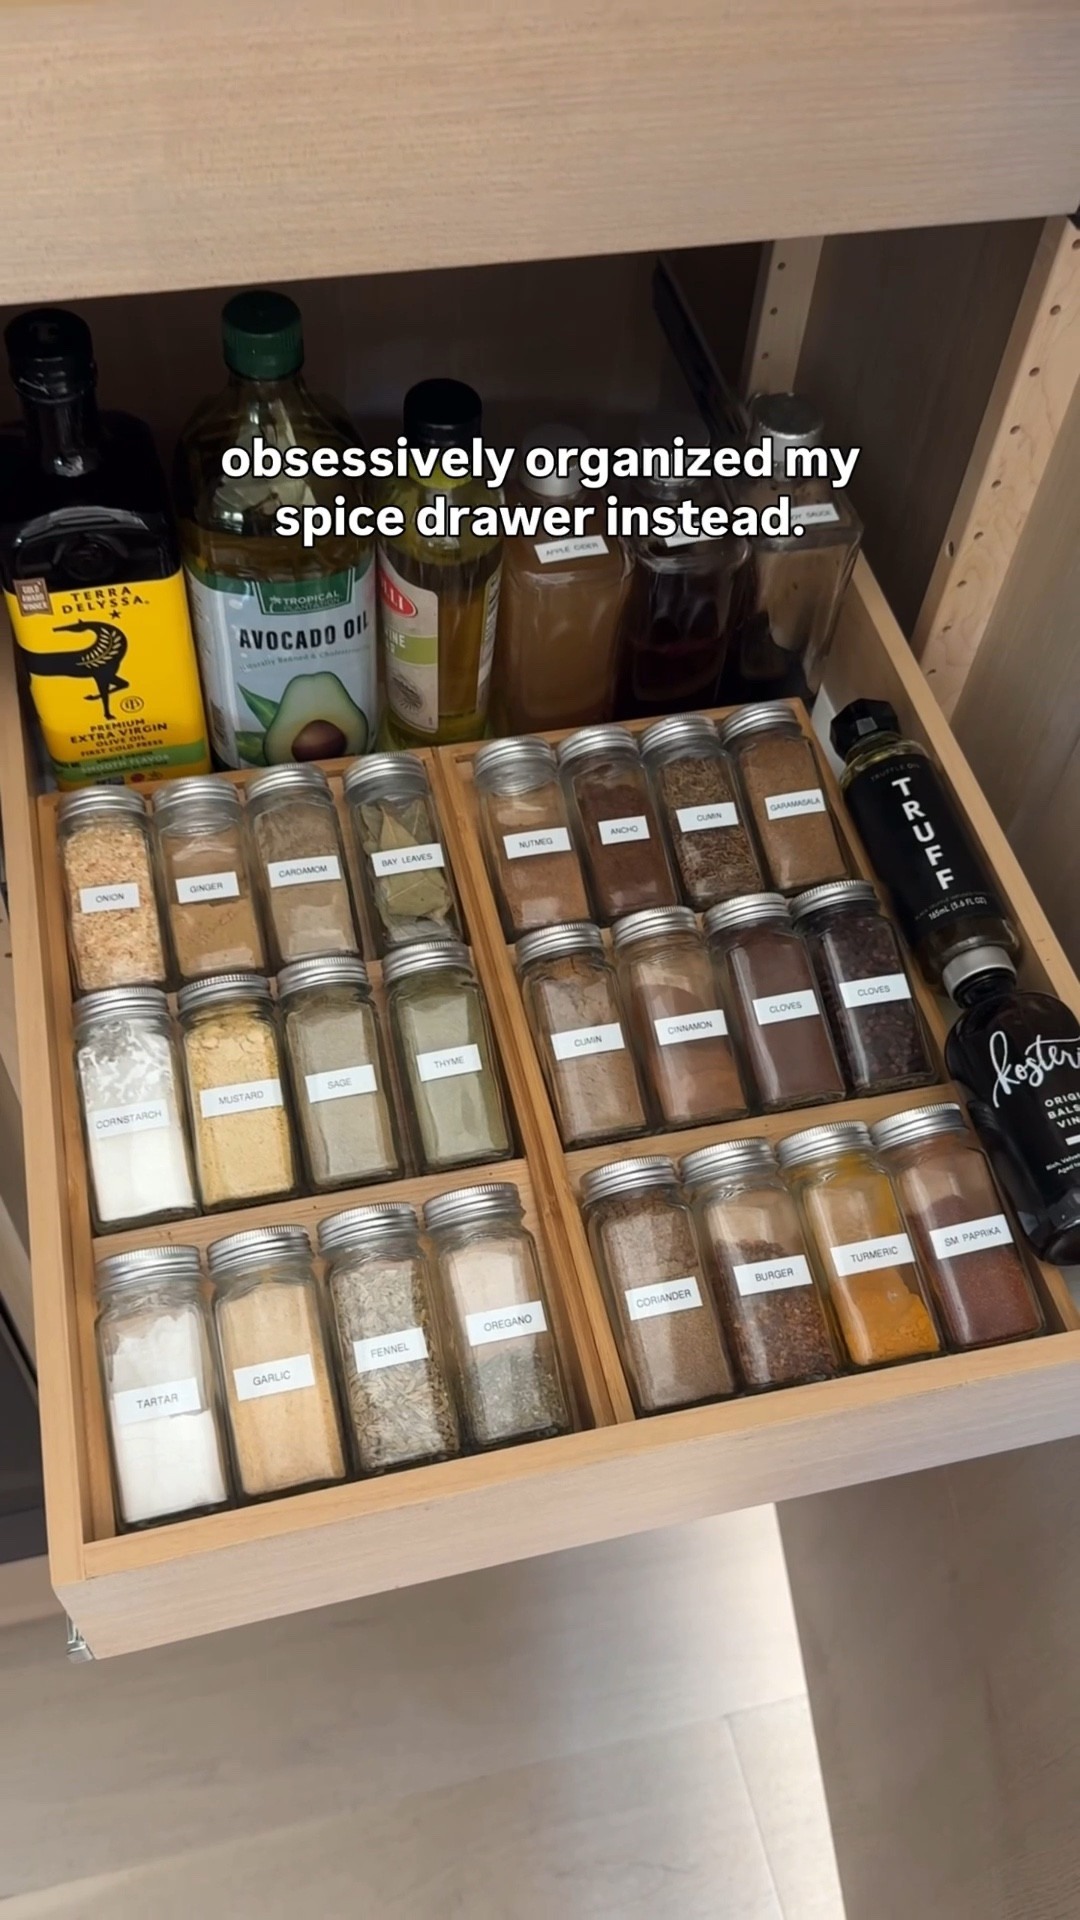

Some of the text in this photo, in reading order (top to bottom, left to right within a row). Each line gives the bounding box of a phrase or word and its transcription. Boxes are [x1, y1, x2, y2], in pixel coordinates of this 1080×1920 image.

[805, 509, 833, 519] SAUCE
[545, 541, 599, 557] APPLE CIDER
[70, 586, 131, 602] TERRA
[283, 590, 339, 605] TROPICAL
[61, 595, 143, 614] DELYSSA
[343, 610, 368, 639] OIL
[240, 625, 336, 650] AVOCADO
[90, 718, 145, 732] PREMIUM
[70, 723, 168, 744] EXTRA VIRGIN
[96, 735, 146, 748] OLIVE OIL
[80, 748, 106, 757] FIRST
[109, 743, 134, 753] COLD
[136, 739, 163, 748] PRESS
[130, 754, 169, 767] FLAVOR
[769, 797, 822, 813] GARAMASALA
[696, 811, 723, 823] CUMIN
[609, 824, 639, 836] ANCHO
[891, 776, 954, 891] TRUFF
[518, 837, 554, 850] NUTMEG
[381, 852, 434, 868] BAY LEAVES
[278, 864, 328, 878] CARDAMOM
[189, 881, 224, 895] GINGER
[95, 892, 125, 904] ONION
[857, 984, 891, 998] CLOVES
[768, 1001, 803, 1015] CLOVES
[667, 1020, 714, 1036] CINNAMON
[573, 1035, 603, 1049] CUMIN
[433, 1055, 465, 1069] THYME
[327, 1077, 353, 1090] SAGE
[218, 1089, 264, 1107] MUSTARD
[95, 1108, 162, 1131] CORNSTARCH
[943, 1225, 1002, 1248] SM PAPRIKA
[850, 1245, 899, 1263] TURMERIC
[755, 1267, 794, 1283] BURGER
[636, 1288, 692, 1308] CORIANDER
[483, 1313, 533, 1333] OREGANO
[370, 1341, 410, 1359] FENNEL
[252, 1369, 291, 1387] GARLIC
[136, 1392, 179, 1410] TARTAR
